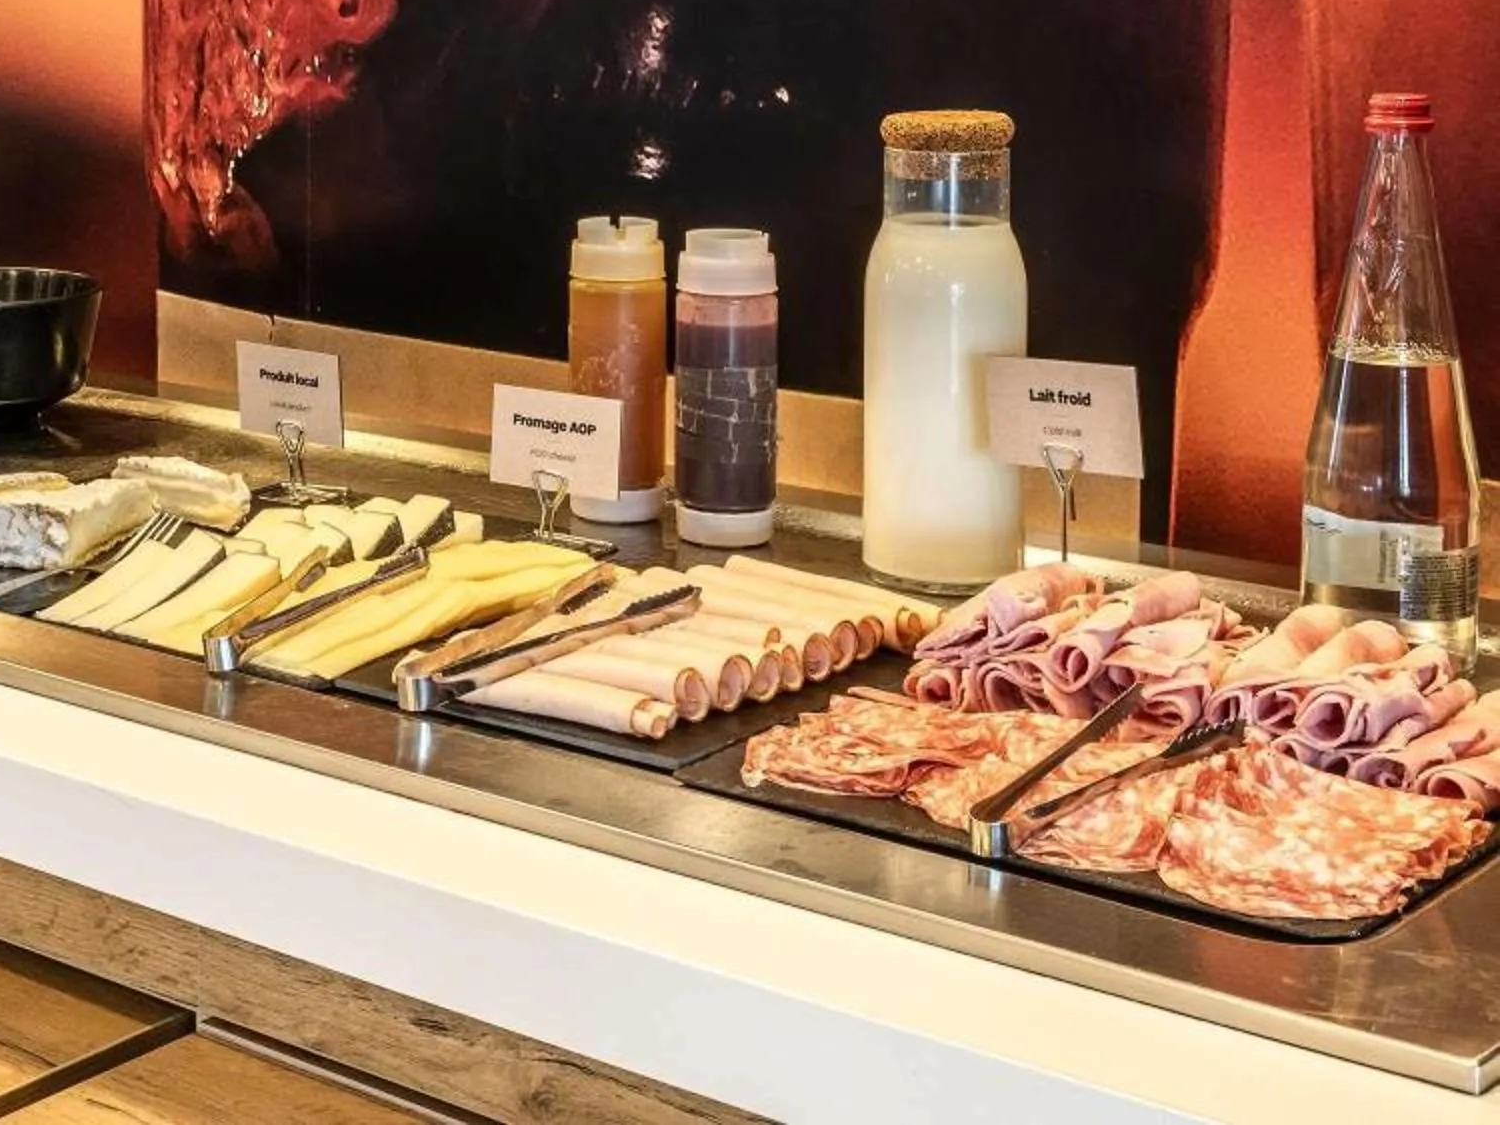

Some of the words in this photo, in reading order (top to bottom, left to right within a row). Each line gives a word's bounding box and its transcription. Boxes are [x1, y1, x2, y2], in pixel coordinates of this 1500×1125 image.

[295, 372, 319, 388] local
[1029, 387, 1057, 404] Lait
[1058, 390, 1092, 407] froid
[513, 413, 567, 434] Fromage
[569, 421, 597, 436] AOP
